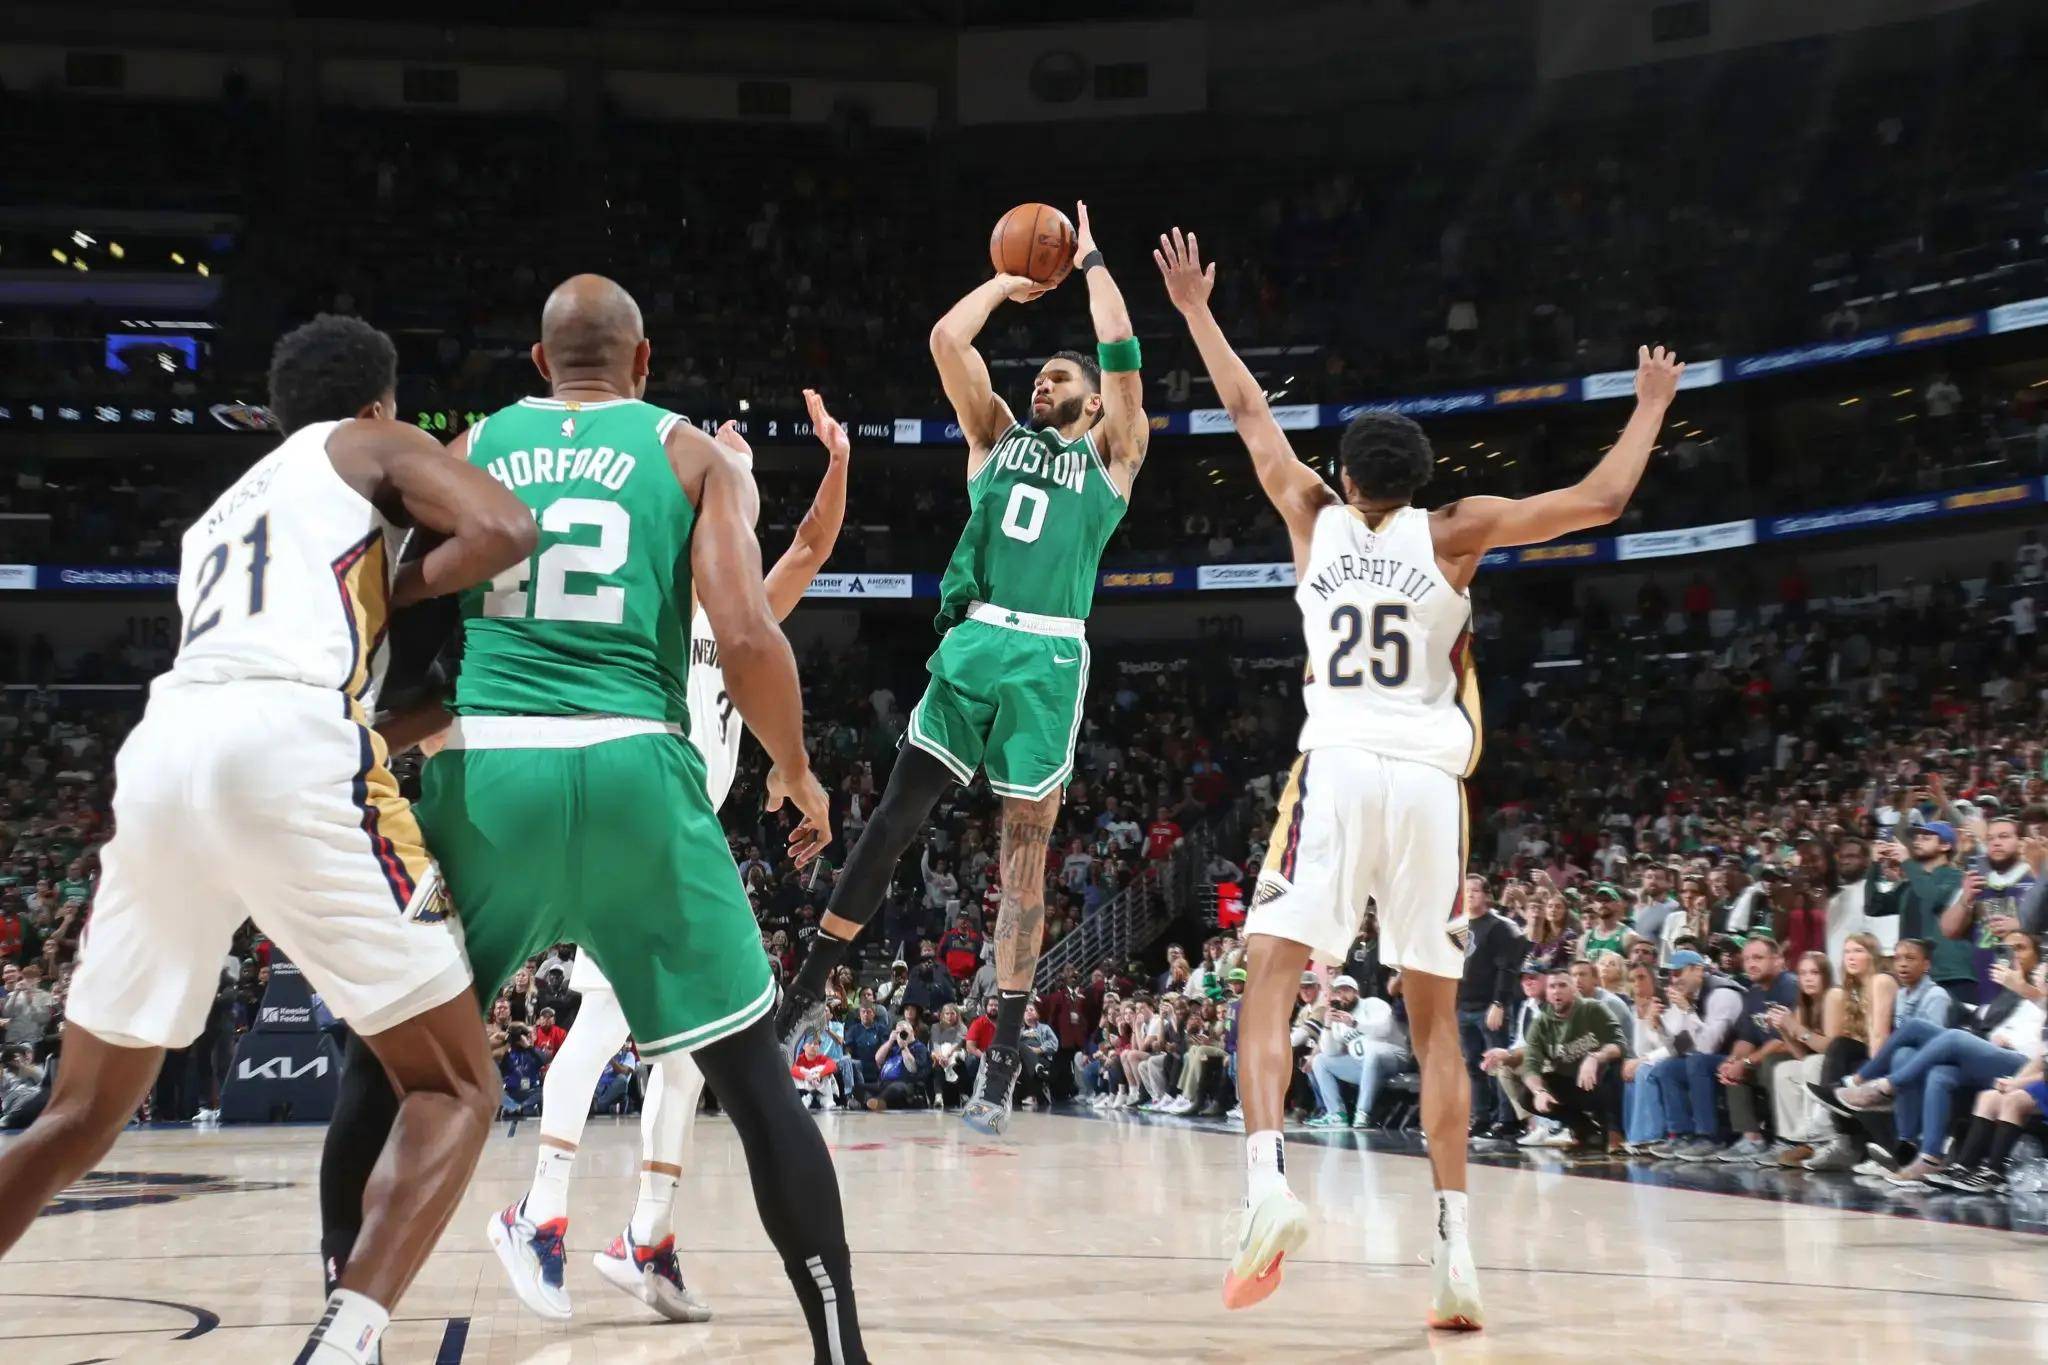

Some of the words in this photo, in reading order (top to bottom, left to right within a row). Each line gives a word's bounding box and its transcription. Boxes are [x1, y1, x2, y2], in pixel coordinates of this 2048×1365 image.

[767, 420, 778, 437] 2
[857, 424, 889, 437] FOULS
[487, 446, 637, 491] HORFORD
[998, 436, 1087, 494] BOSTON
[1000, 481, 1050, 544] 0
[183, 510, 272, 648] 21
[1311, 554, 1403, 601] MURPHY
[1400, 567, 1436, 602] III
[1328, 603, 1410, 689] 25
[279, 1006, 310, 1015] Keesler
[279, 1014, 310, 1023] Federal
[238, 1056, 329, 1079] KIA
